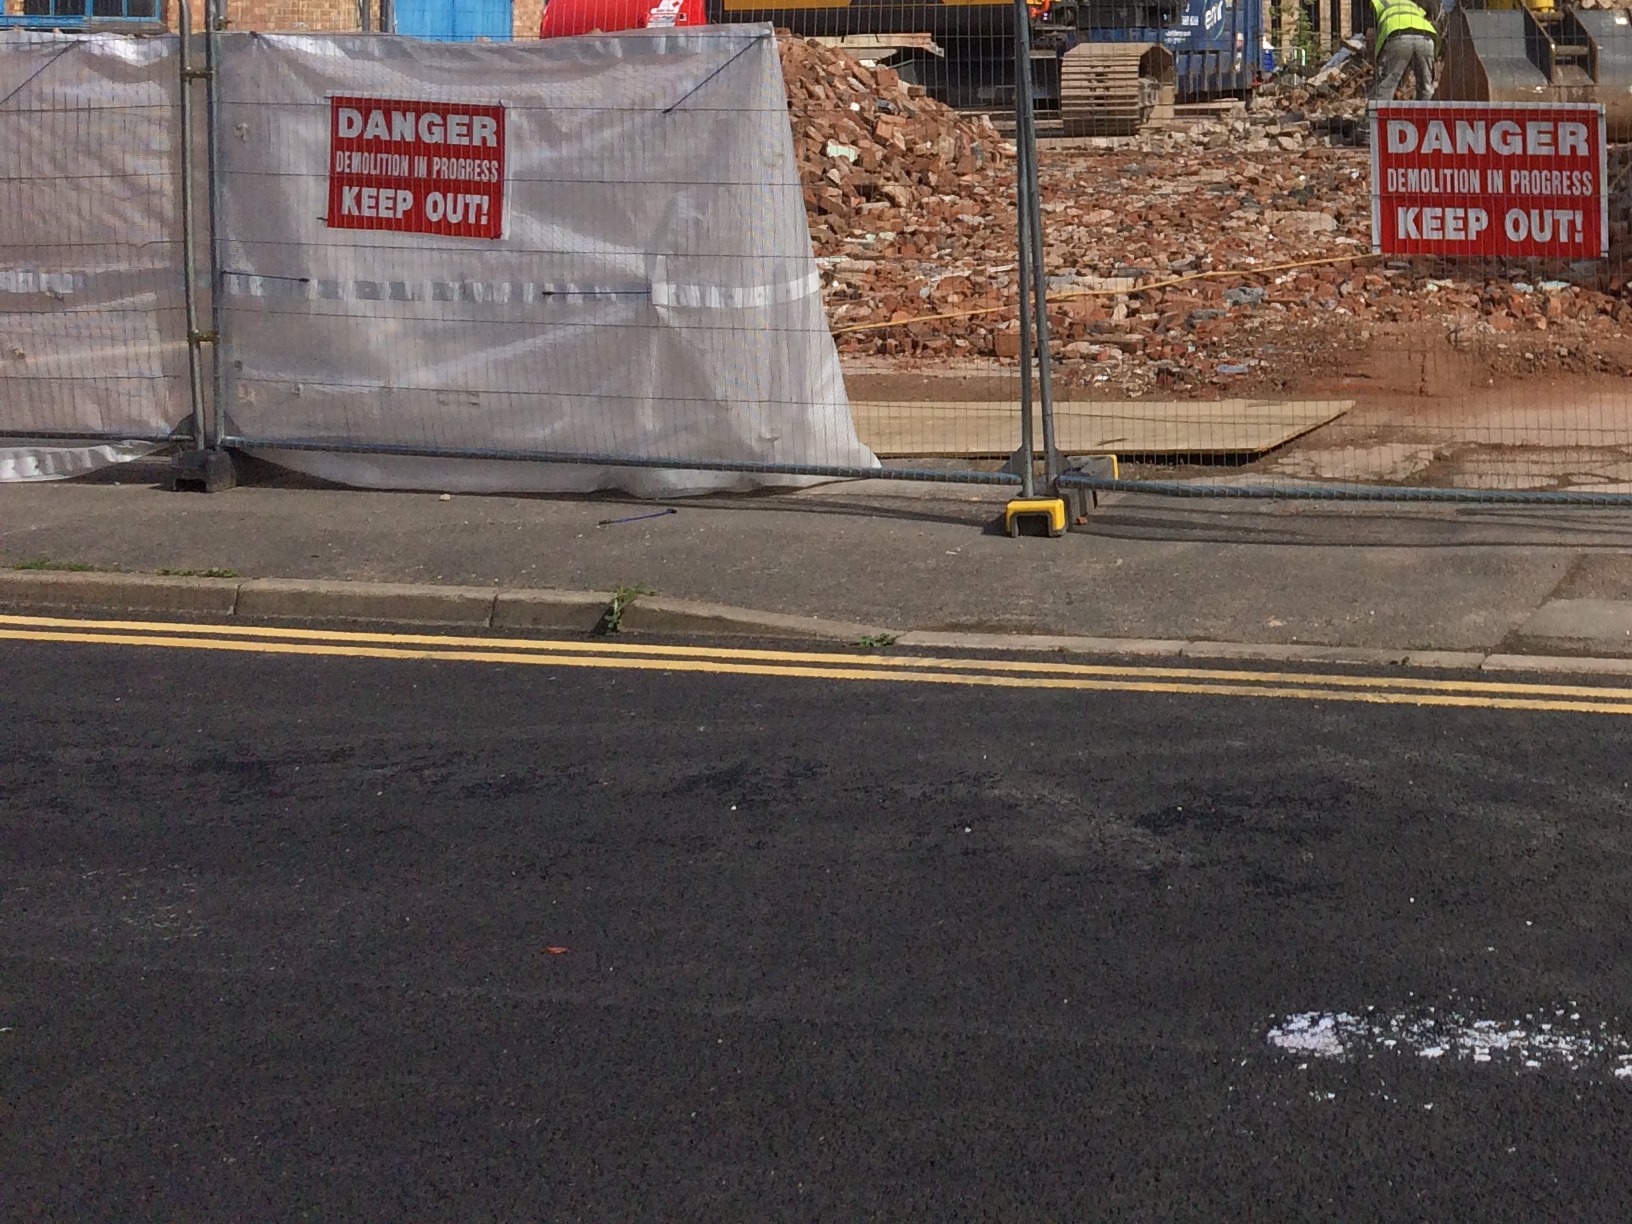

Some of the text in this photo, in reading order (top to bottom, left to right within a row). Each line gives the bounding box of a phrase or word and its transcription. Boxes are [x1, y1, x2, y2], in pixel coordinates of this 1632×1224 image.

[338, 107, 498, 147] DANGER
[1386, 120, 1590, 156] DANGER
[336, 151, 499, 183] DEMOLITION IN PROGRESS
[1387, 168, 1593, 196] DEMOLITION IN PROGRESS
[341, 185, 489, 225] KEEP OUT!
[1397, 206, 1584, 243] KEEP OUT!
